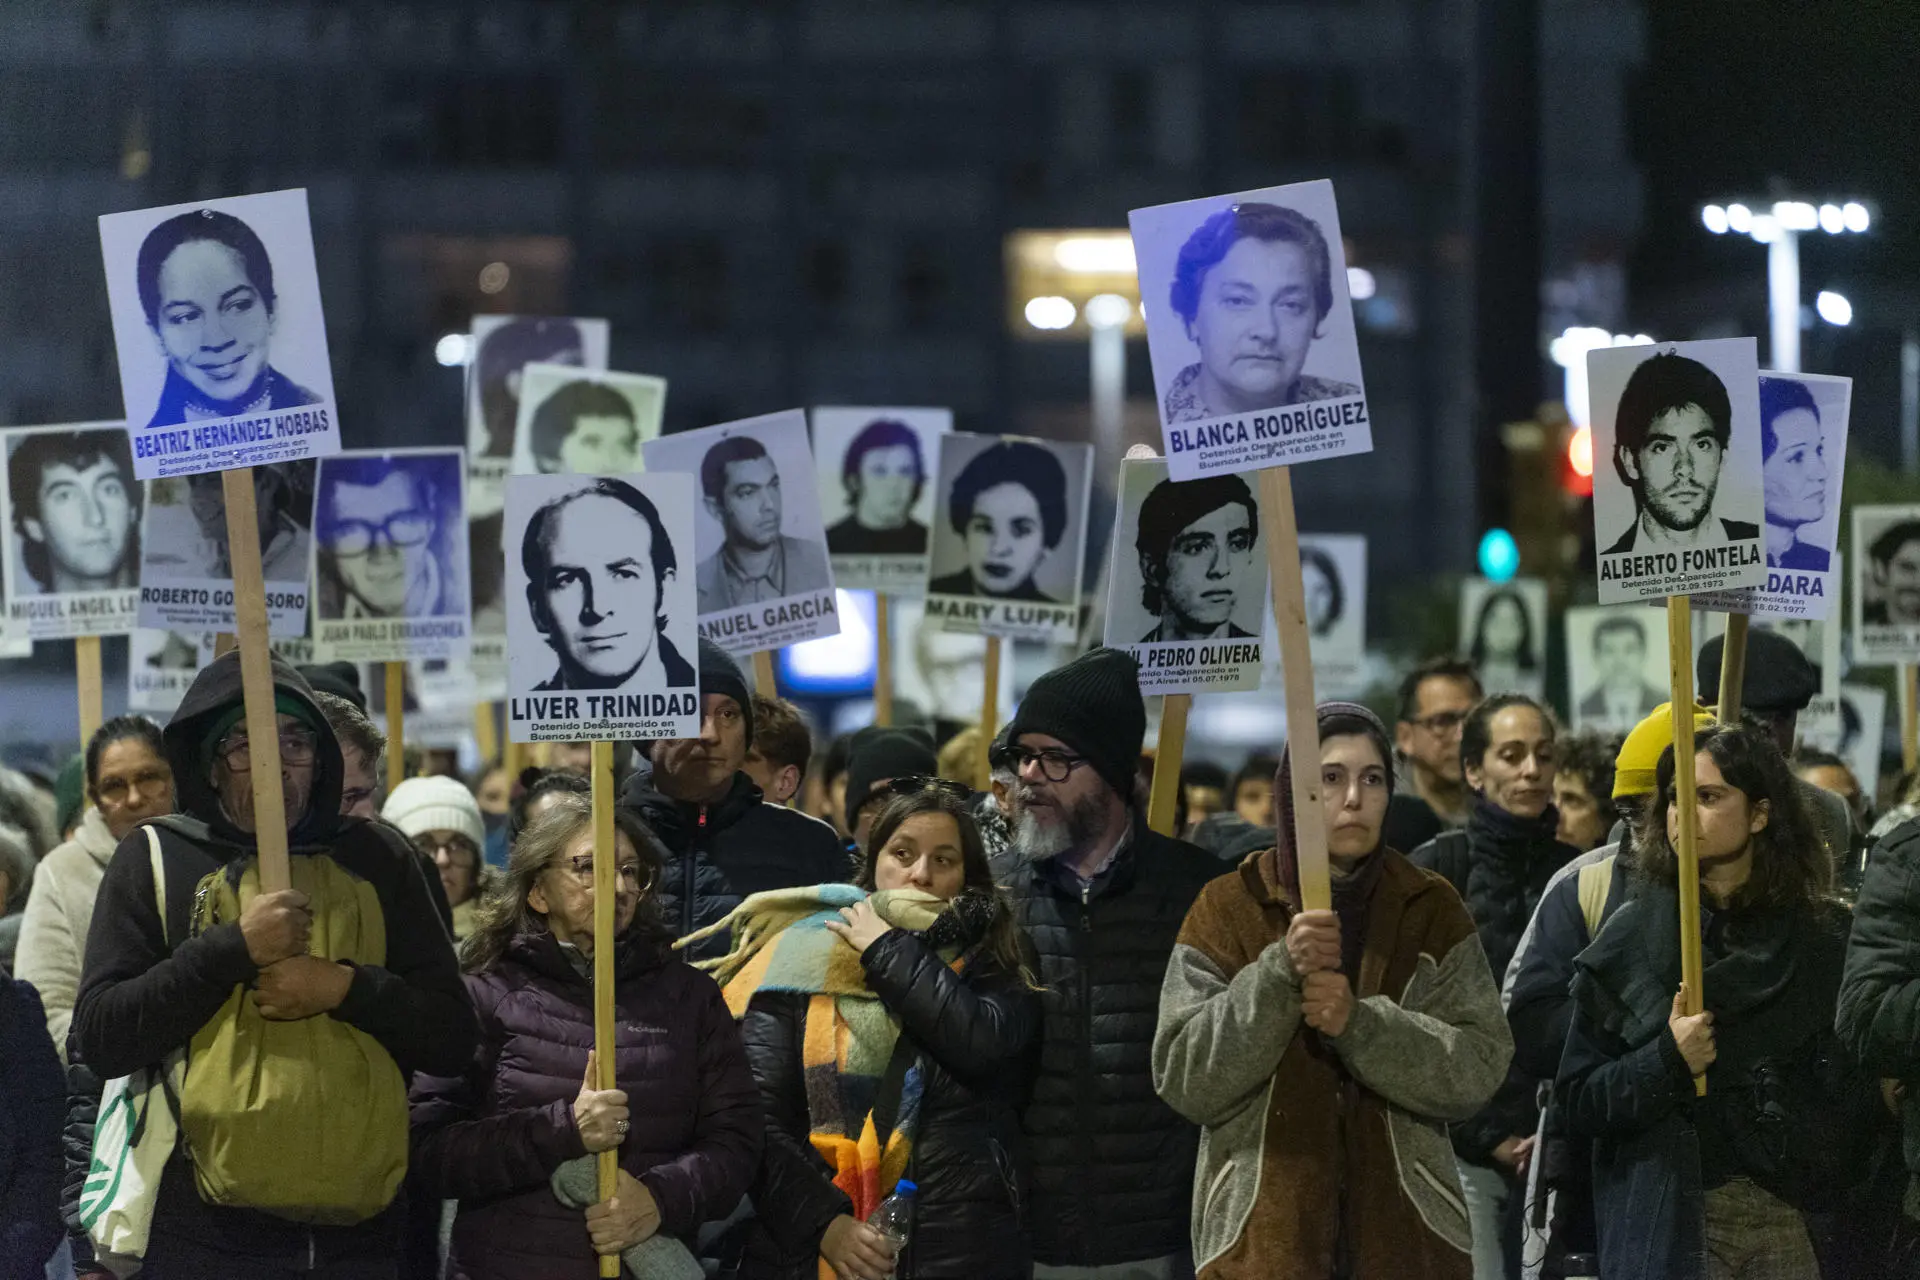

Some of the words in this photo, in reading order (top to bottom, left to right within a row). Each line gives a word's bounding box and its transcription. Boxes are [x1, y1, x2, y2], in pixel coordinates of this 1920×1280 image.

[136, 430, 191, 458] BEATRIZ
[193, 418, 273, 450] HERNÁNDEZ
[275, 409, 329, 437] HOBBAS
[1170, 420, 1249, 453] BLANCA
[1253, 403, 1367, 440] RODRÍGUEZ
[159, 453, 209, 466] Detenida
[212, 441, 290, 458] Desparecida
[1199, 447, 1249, 460] Detenida
[1251, 434, 1326, 451] Desaparecida
[1329, 431, 1343, 439] en
[1199, 457, 1241, 470] Buenos
[1276, 449, 1286, 457] el
[1289, 440, 1346, 455] 16.05.1977
[159, 464, 201, 476] Buenos
[205, 459, 235, 469] Aires
[250, 447, 310, 462] 05.07.1977
[1601, 553, 1677, 580] ALBERTO
[1683, 543, 1760, 571] FONTELA
[1622, 577, 1662, 589] Detenido
[1639, 586, 1662, 595] Chile
[1665, 585, 1673, 593] el
[1676, 580, 1724, 591] 12.09.1973
[1745, 573, 1824, 597] DARA
[11, 602, 64, 619] MIGUEL
[69, 598, 114, 616] ANGEL
[142, 588, 208, 605] ROBERTO
[213, 591, 305, 609] GOSORO
[1754, 603, 1806, 613] 18.02.1977
[698, 612, 758, 638] ANUEL
[763, 592, 835, 627] GARCÍA
[928, 600, 994, 620] MARY
[1004, 606, 1074, 628] LUPPI
[1148, 648, 1195, 668] PEDRO
[1199, 644, 1260, 665] OLIVERA
[1164, 668, 1225, 676] Desparecido
[512, 697, 579, 720] LIVER
[586, 693, 697, 718] TRINIDAD
[531, 721, 580, 731] Detenido
[583, 719, 658, 730] Desaparecido
[531, 733, 571, 741] Buenos
[619, 729, 676, 738] 13.04.1976
